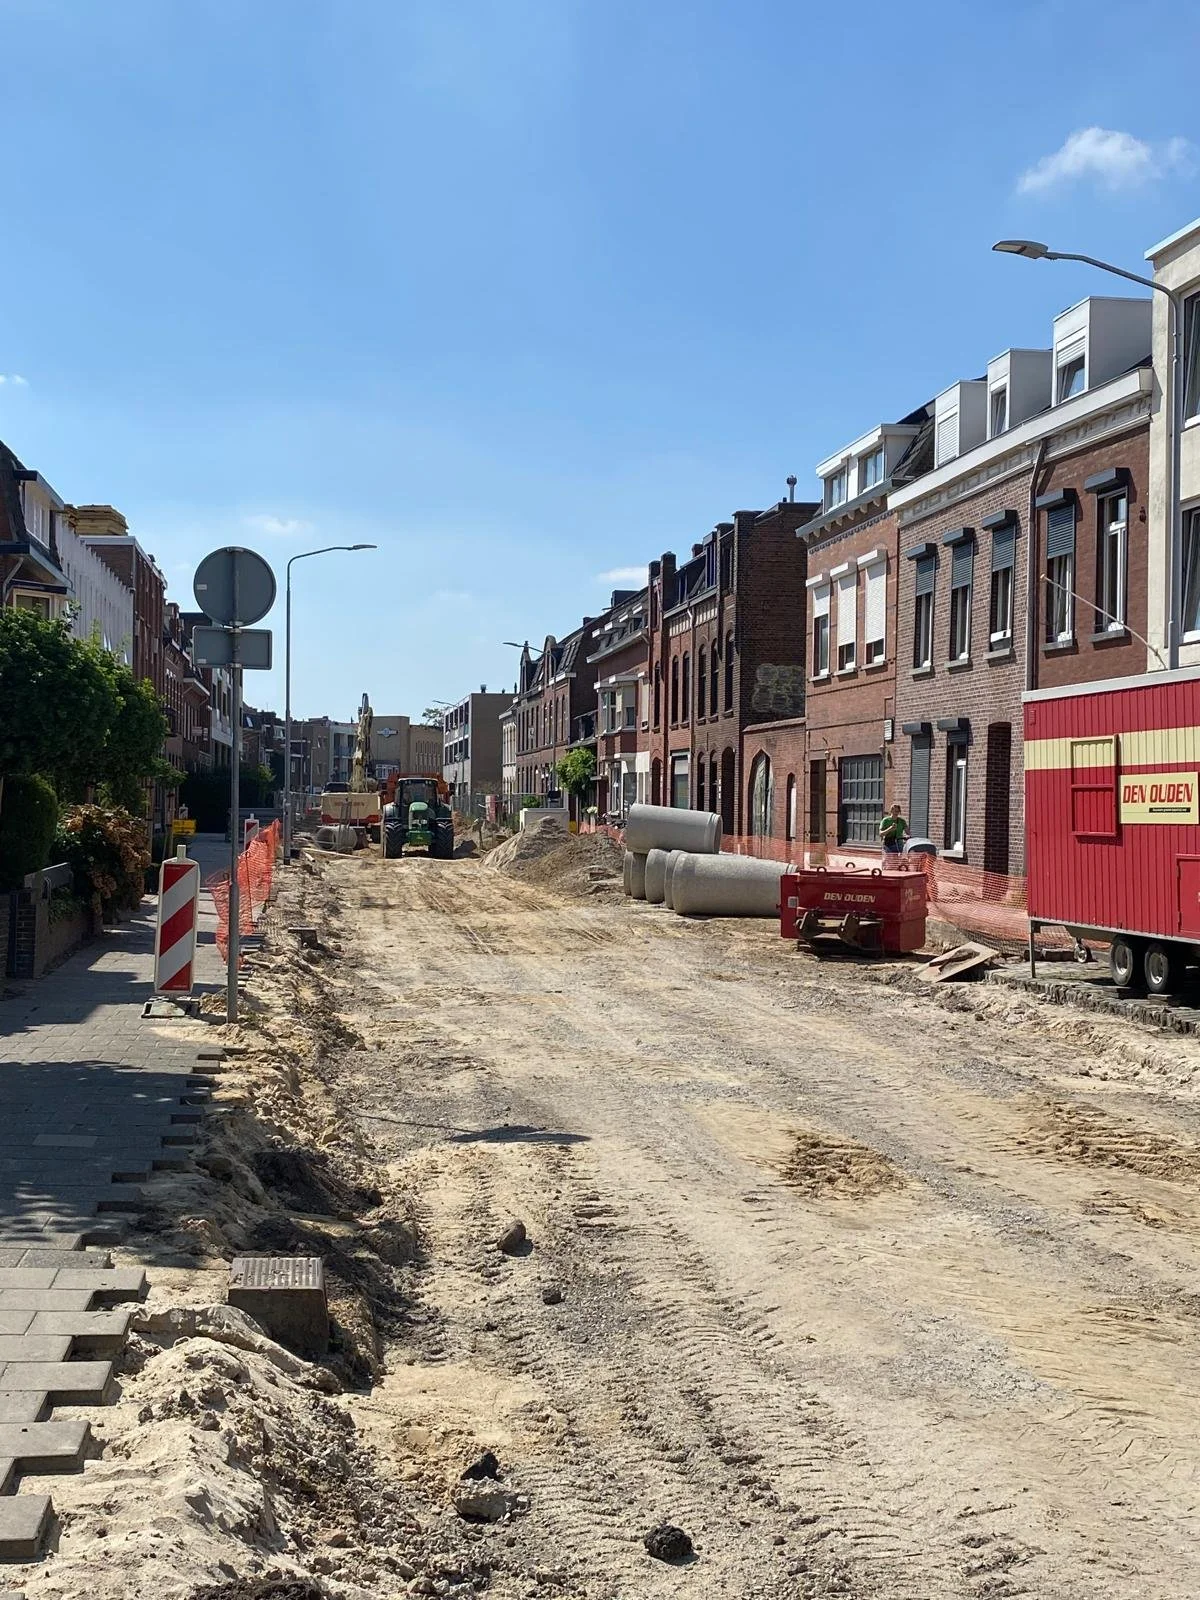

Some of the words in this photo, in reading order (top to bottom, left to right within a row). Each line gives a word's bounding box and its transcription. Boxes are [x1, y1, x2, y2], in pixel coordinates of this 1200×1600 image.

[1122, 784, 1147, 804] DEN
[1149, 783, 1194, 803] OUDEN
[823, 892, 843, 901] DEN
